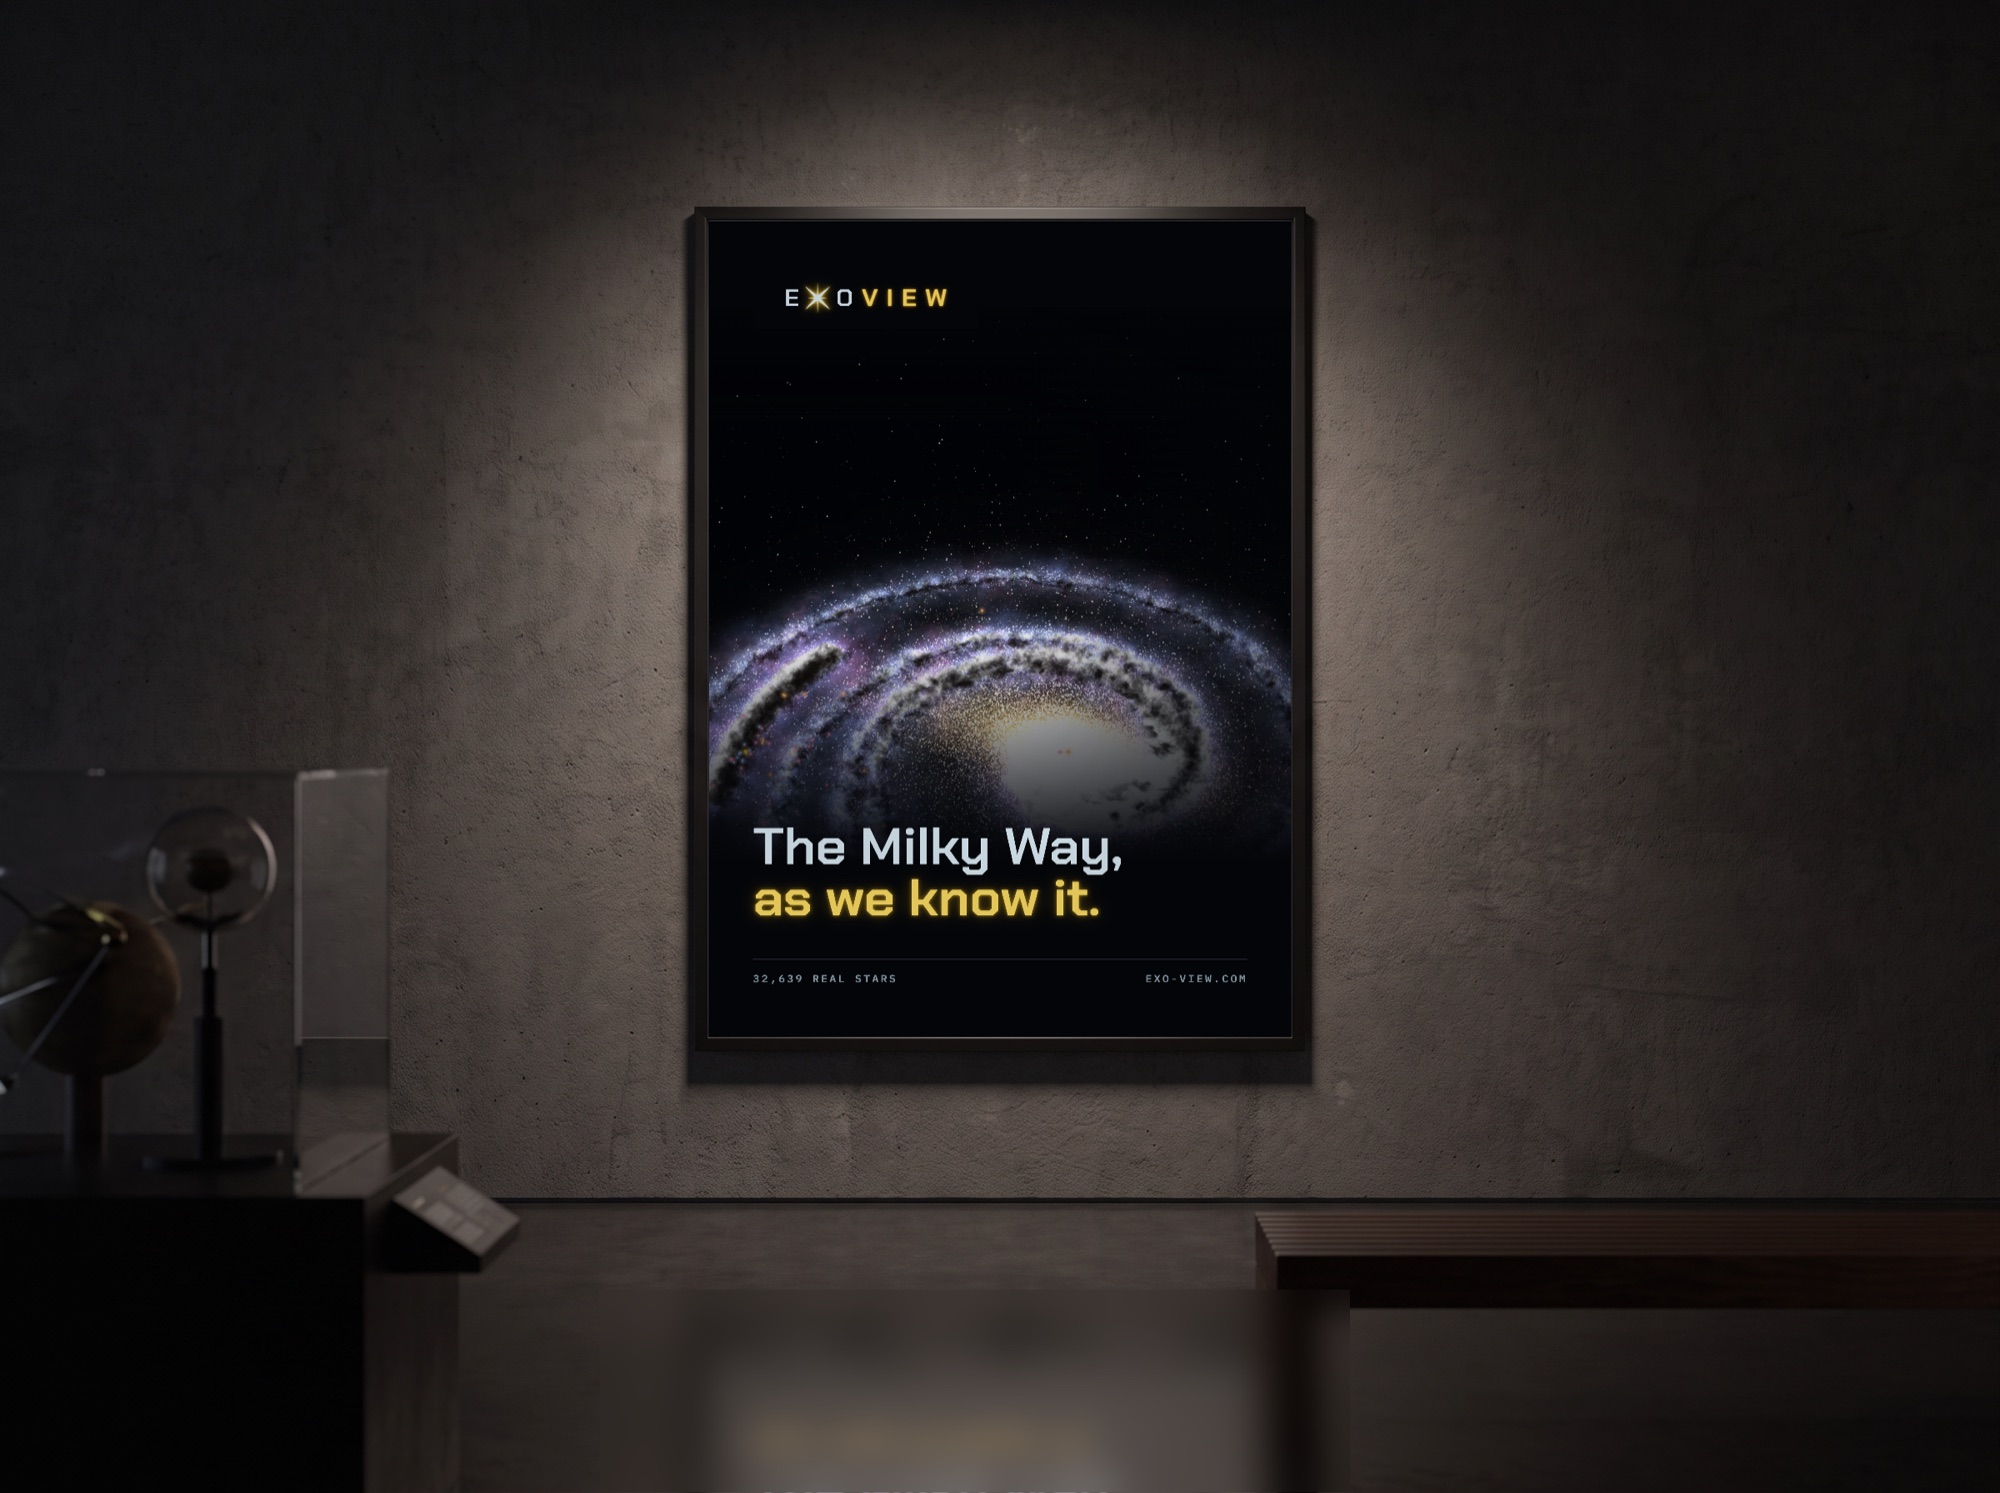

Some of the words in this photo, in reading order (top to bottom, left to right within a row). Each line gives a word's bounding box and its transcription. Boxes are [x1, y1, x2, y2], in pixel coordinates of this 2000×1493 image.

[753, 827, 845, 865] The
[862, 827, 989, 876] Milky
[1005, 827, 1122, 876] Way,
[754, 888, 811, 916] as
[826, 889, 894, 916] we
[910, 879, 1039, 916] know
[1055, 879, 1100, 916] it.
[752, 974, 803, 985] 32,639
[812, 974, 845, 983] REAL
[855, 974, 896, 983] STARS
[1145, 974, 1246, 983] EXO-VIEW.COM
